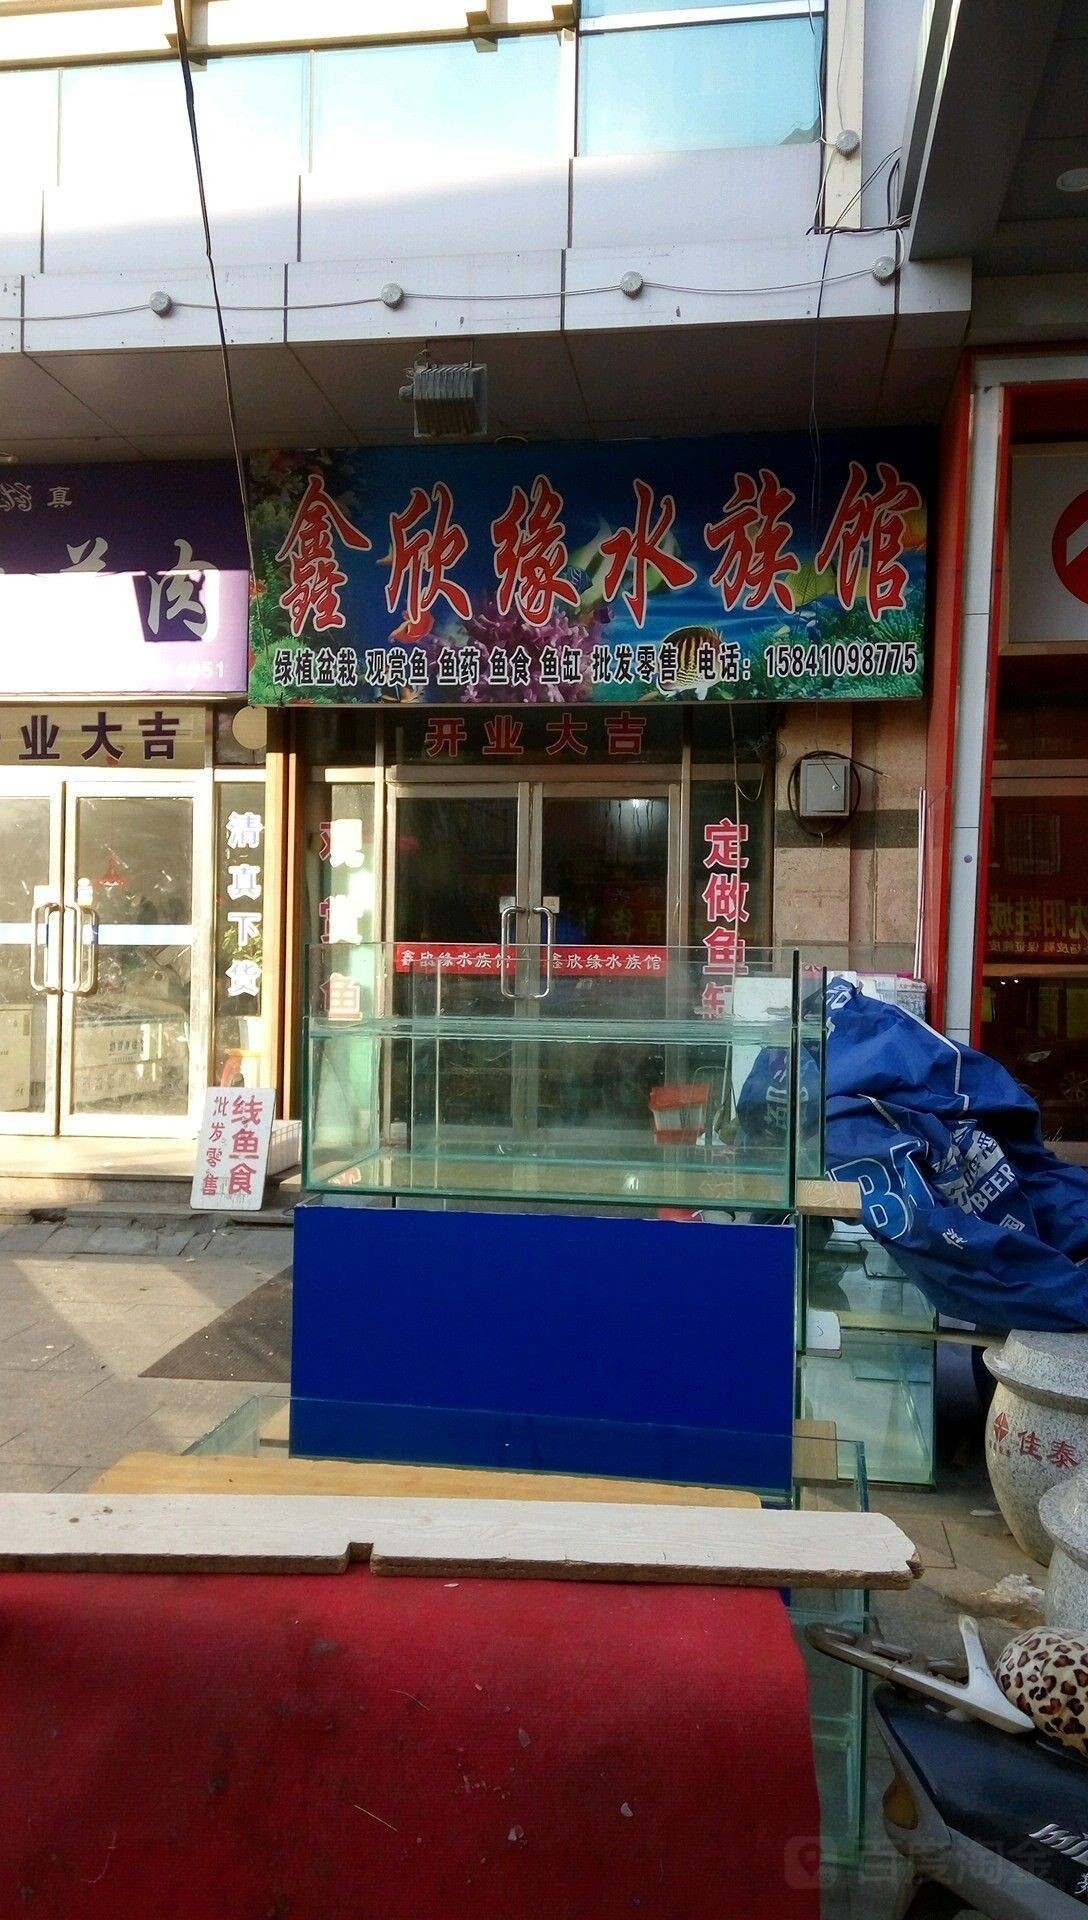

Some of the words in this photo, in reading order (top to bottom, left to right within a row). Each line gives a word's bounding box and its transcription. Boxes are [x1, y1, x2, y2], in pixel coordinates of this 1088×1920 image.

[276, 461, 923, 636] 鑫欣缘水族馆
[273, 648, 358, 686] 绿植盆栽
[366, 648, 429, 686] 观赏鱼
[437, 647, 480, 685] 鱼药
[488, 647, 532, 685] 鱼食
[540, 646, 582, 684] 鱼缸
[591, 645, 679, 683] 批发零售
[764, 642, 918, 677] 15841098775
[18, 711, 180, 760] 业大吉
[425, 711, 647, 757] 开业大吉
[225, 811, 264, 997] 清真下货
[202, 1096, 229, 1196] 批发零售
[229, 1095, 263, 1195] 线鱼食
[971, 1163, 1016, 1213] BEER
[1017, 1431, 1080, 1469] 佳泰
